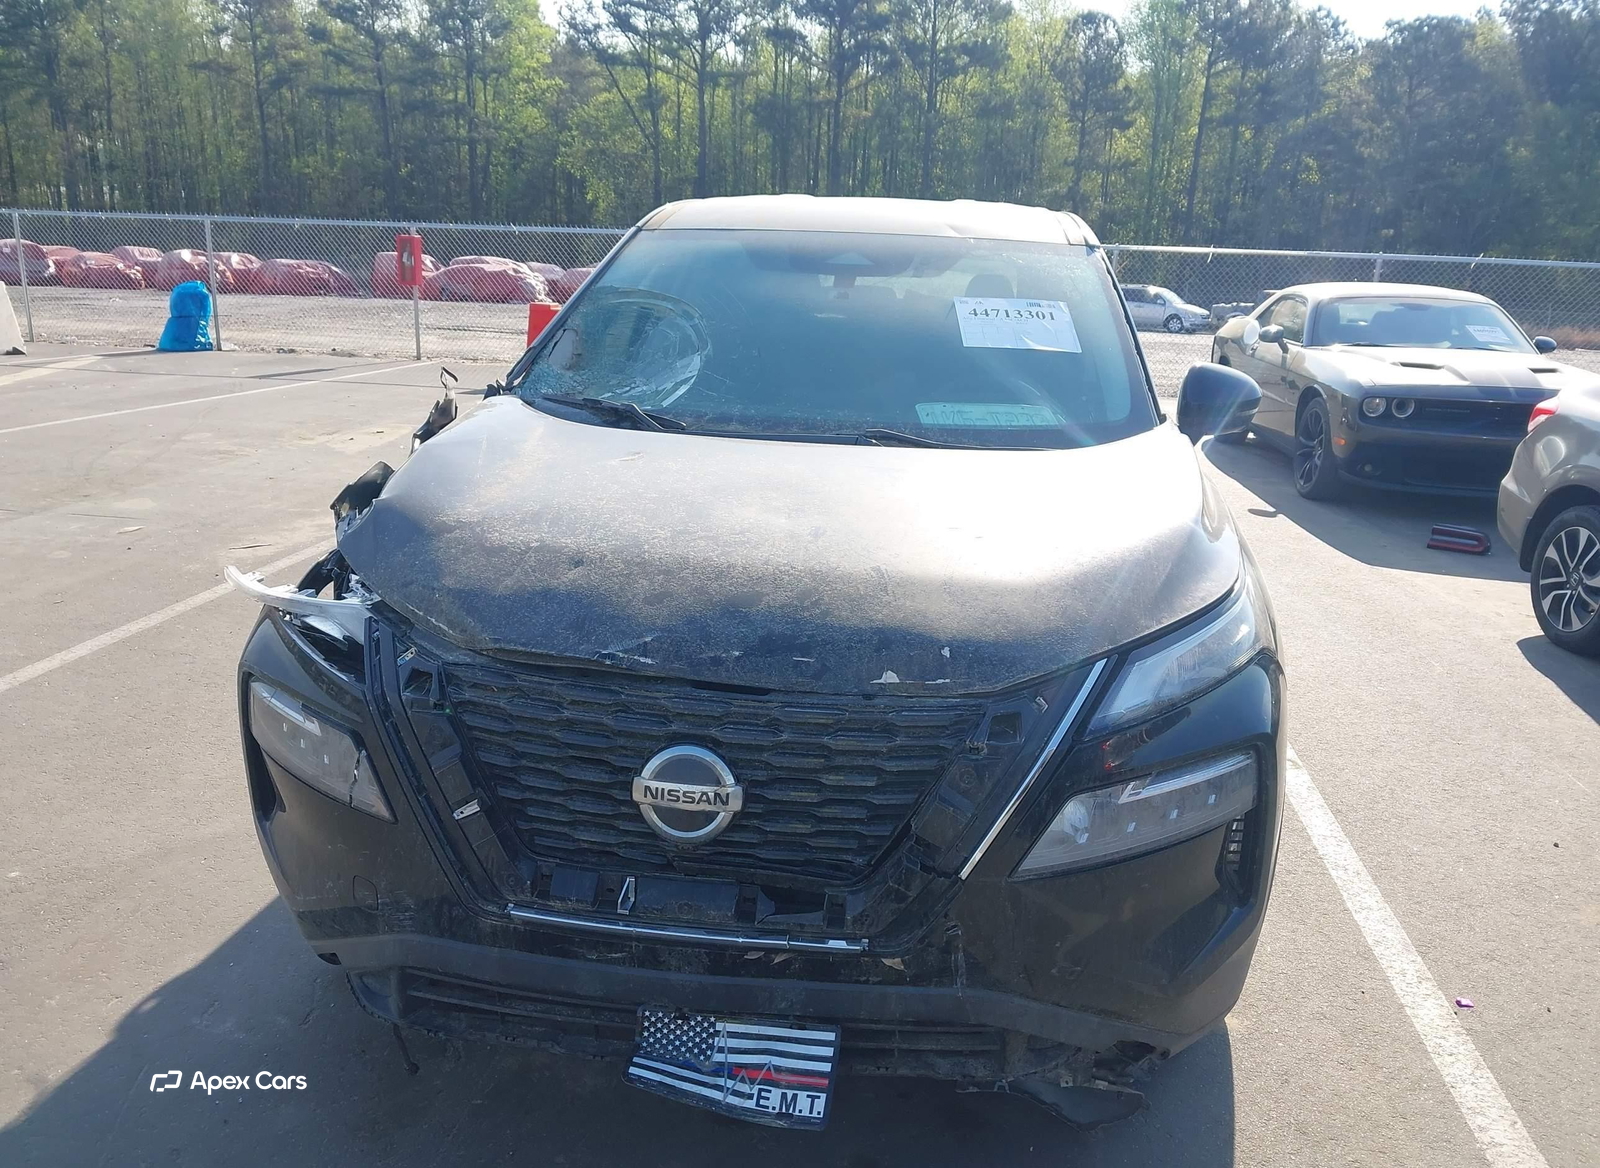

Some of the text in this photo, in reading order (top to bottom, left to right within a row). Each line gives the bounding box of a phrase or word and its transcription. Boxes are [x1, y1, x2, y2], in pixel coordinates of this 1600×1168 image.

[968, 307, 1055, 321] 44713301
[643, 785, 730, 807] NISSAN
[754, 1087, 823, 1116] E.M.T.
